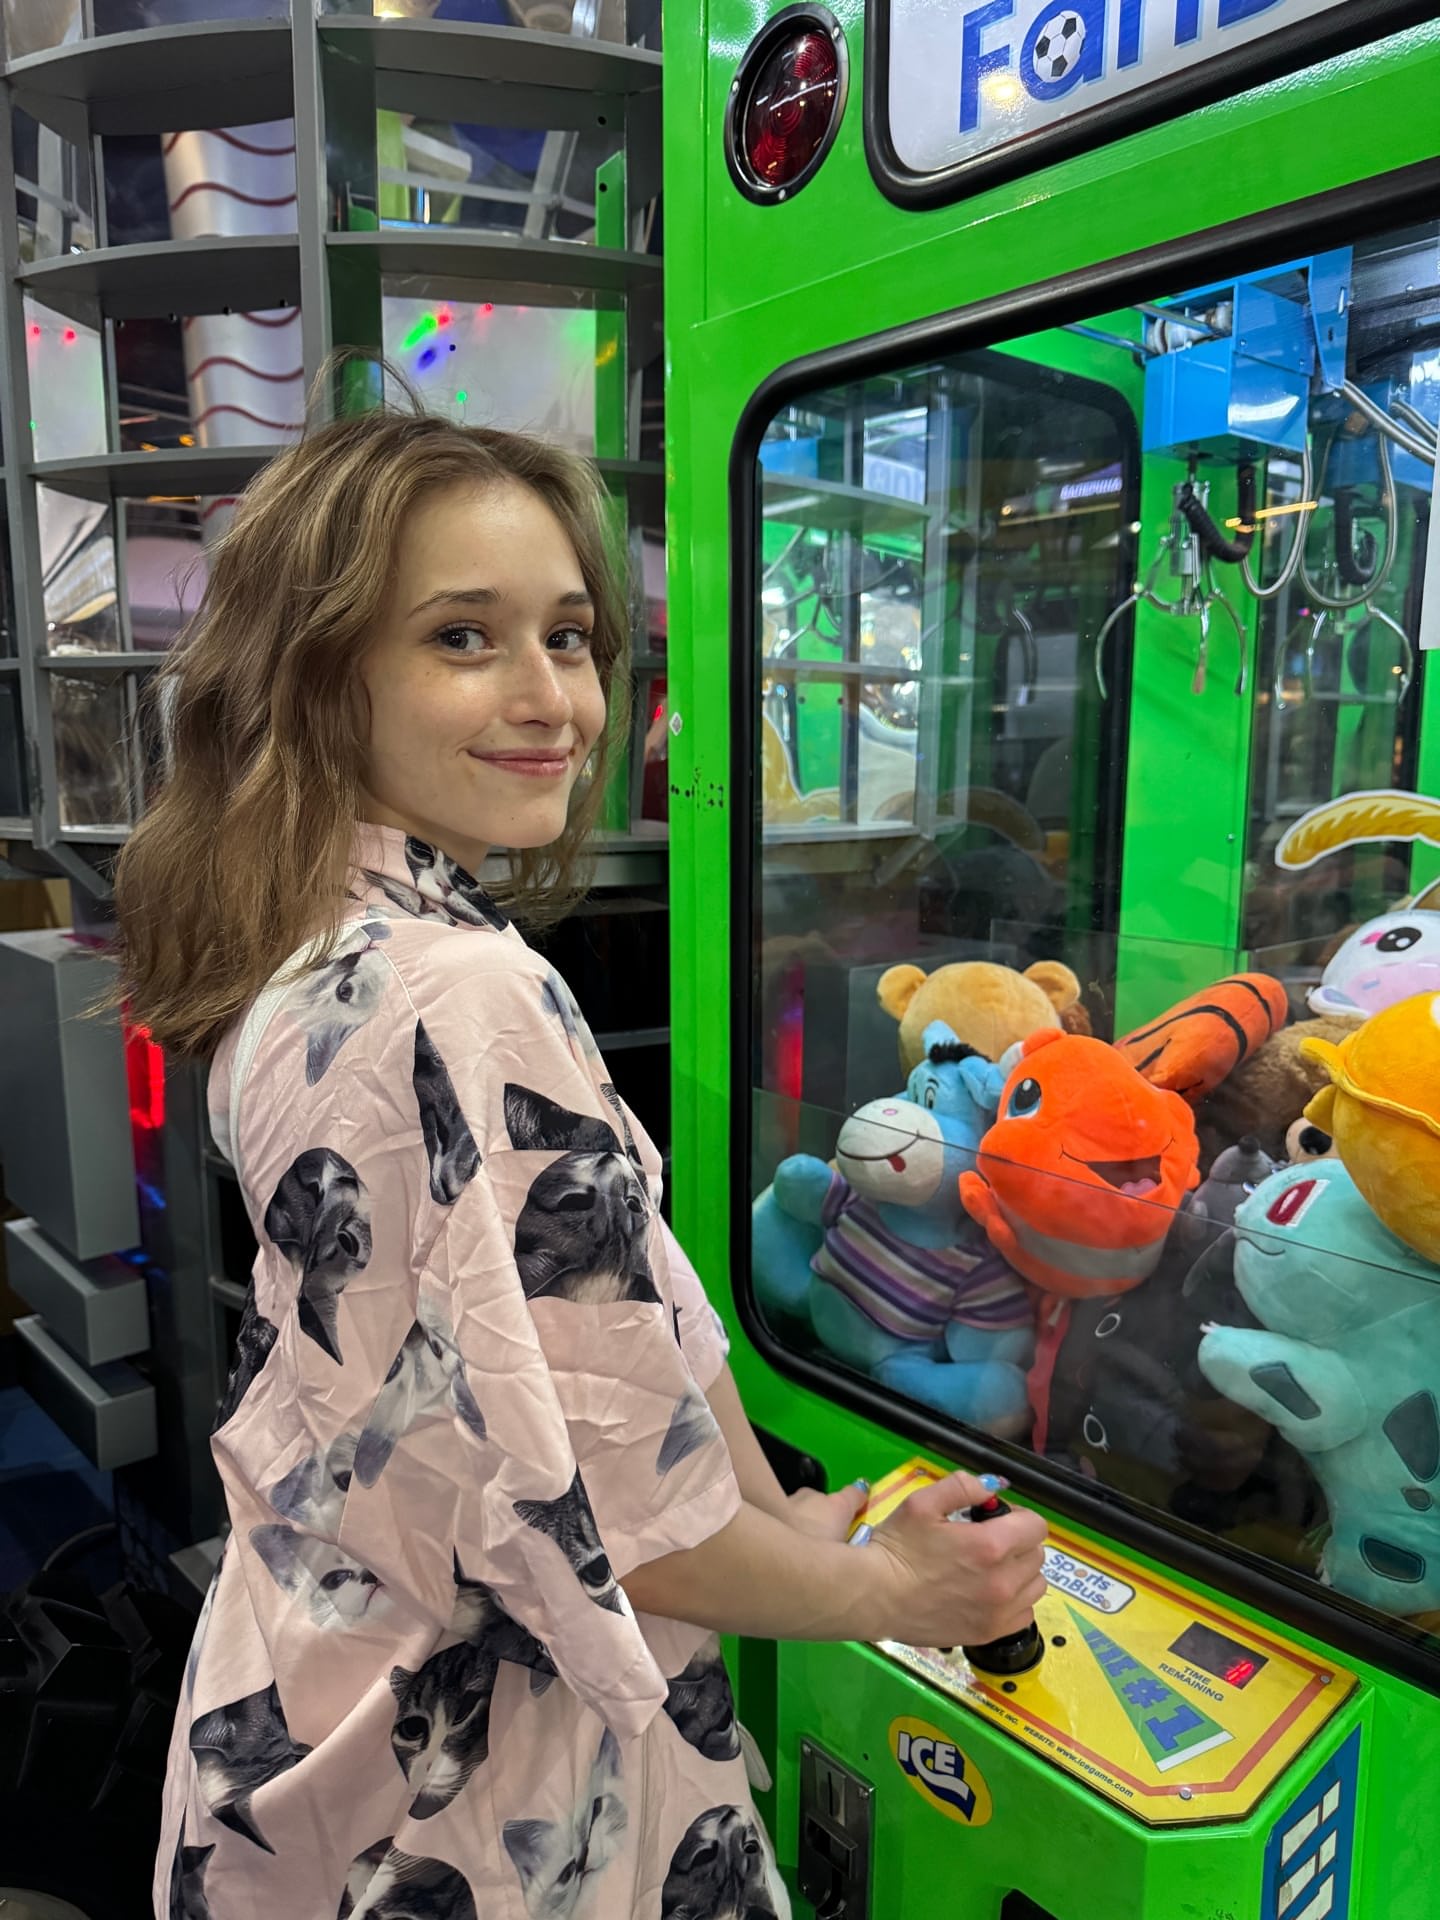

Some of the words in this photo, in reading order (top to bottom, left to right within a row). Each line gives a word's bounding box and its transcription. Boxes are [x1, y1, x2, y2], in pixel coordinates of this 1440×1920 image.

[1159, 1662, 1224, 1701] REMAINING
[1183, 1666, 1212, 1685] TIME
[897, 1730, 972, 1803] ICE
[1055, 1745, 1134, 1798] www.icegame.com
